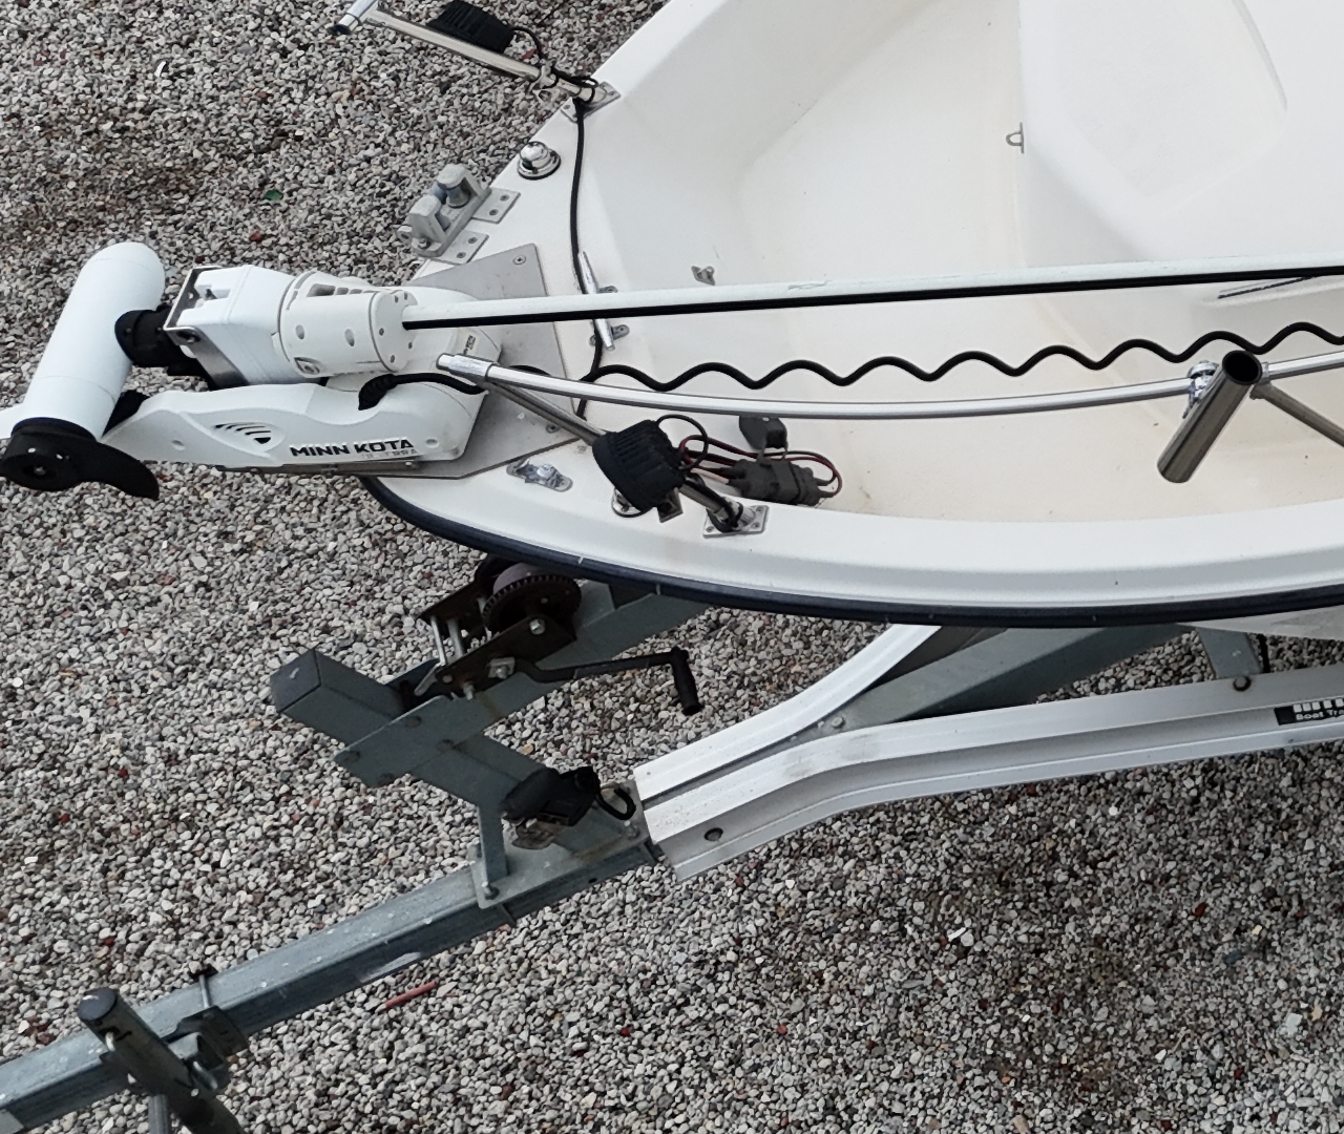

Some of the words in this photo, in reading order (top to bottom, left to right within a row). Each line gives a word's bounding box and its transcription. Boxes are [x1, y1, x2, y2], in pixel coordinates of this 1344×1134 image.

[289, 443, 350, 457] MINN
[353, 439, 414, 454] KOTA
[1295, 711, 1324, 721] Boat
